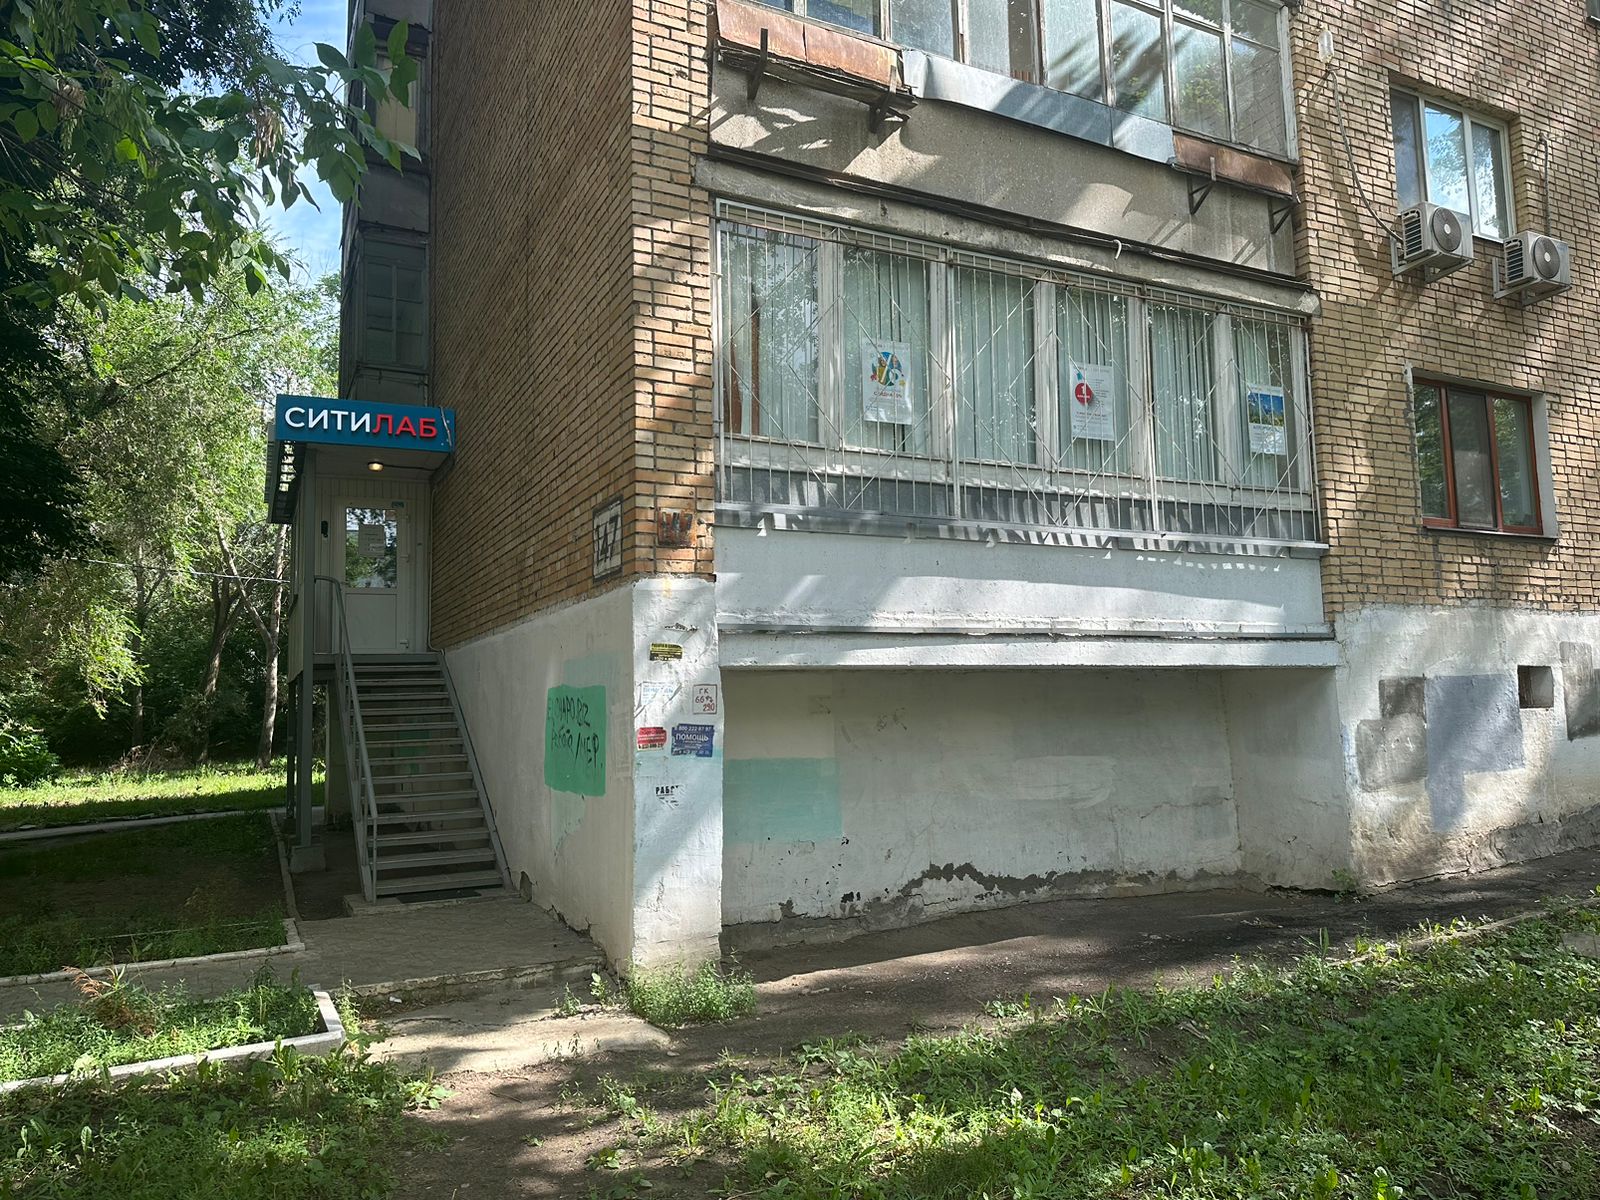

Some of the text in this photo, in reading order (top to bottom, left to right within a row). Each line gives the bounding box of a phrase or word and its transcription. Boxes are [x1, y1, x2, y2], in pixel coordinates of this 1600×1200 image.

[284, 407, 438, 438] СИТИЛАБ
[595, 514, 620, 567] 147
[675, 733, 709, 742] ПОМОЩЬ
